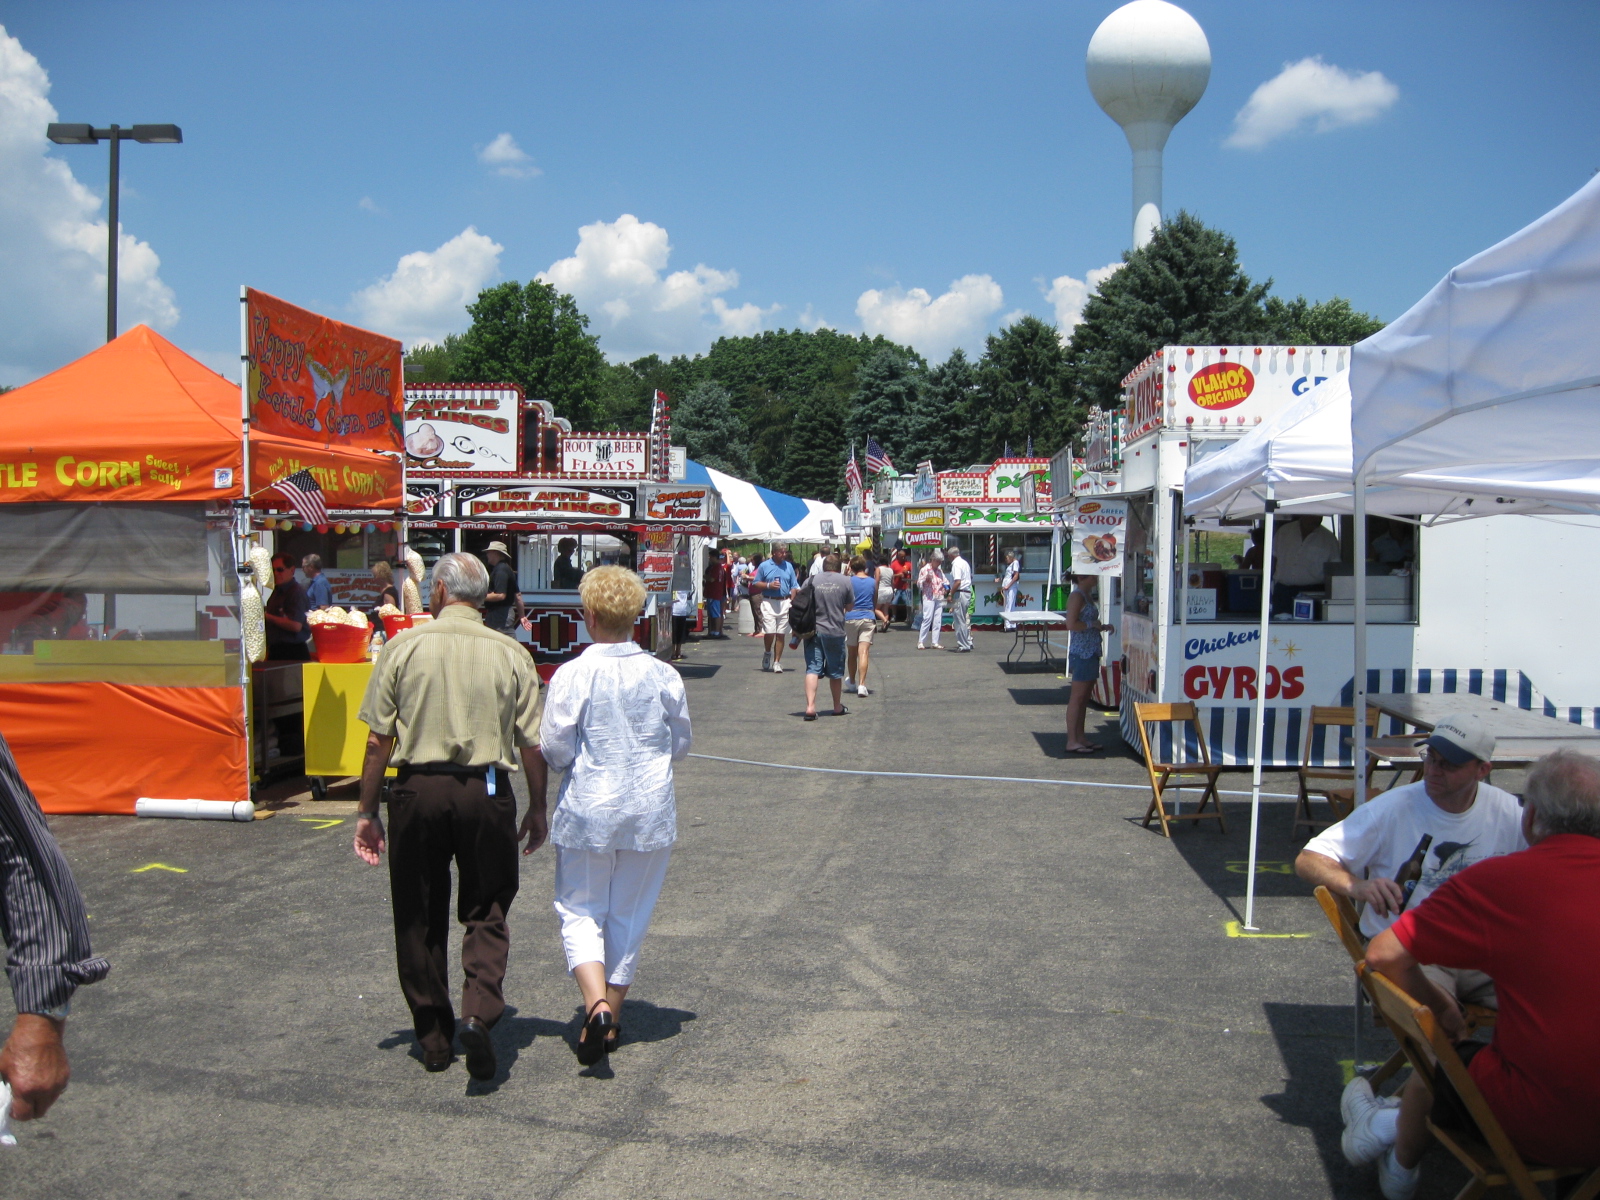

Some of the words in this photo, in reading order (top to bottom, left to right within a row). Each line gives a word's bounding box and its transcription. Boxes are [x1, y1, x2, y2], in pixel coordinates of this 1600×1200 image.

[251, 316, 305, 381] Happy
[351, 351, 391, 396] Hour
[1192, 366, 1247, 395] VLAHOS
[258, 373, 316, 428] Kettle
[367, 409, 386, 429] LLC
[405, 391, 456, 399] utana's
[408, 398, 500, 410] APPLE
[1196, 387, 1247, 407] ORIGINAL
[405, 410, 509, 434] PLINGS
[564, 441, 594, 453] ROOT
[614, 441, 643, 453] BEER
[56, 455, 142, 489] CORN
[145, 454, 179, 473] Sweet
[571, 458, 635, 471] FLOATS
[150, 469, 182, 490] Salty
[499, 490, 531, 500] HOT
[535, 491, 590, 501] APPLE
[470, 500, 622, 516] DUMPLINGS
[907, 510, 942, 523] LEMONADE
[1078, 515, 1124, 525] GYROS
[905, 533, 942, 545] CAVATELLI
[1185, 629, 1260, 660] Chicken
[1184, 664, 1305, 700] GYROS
